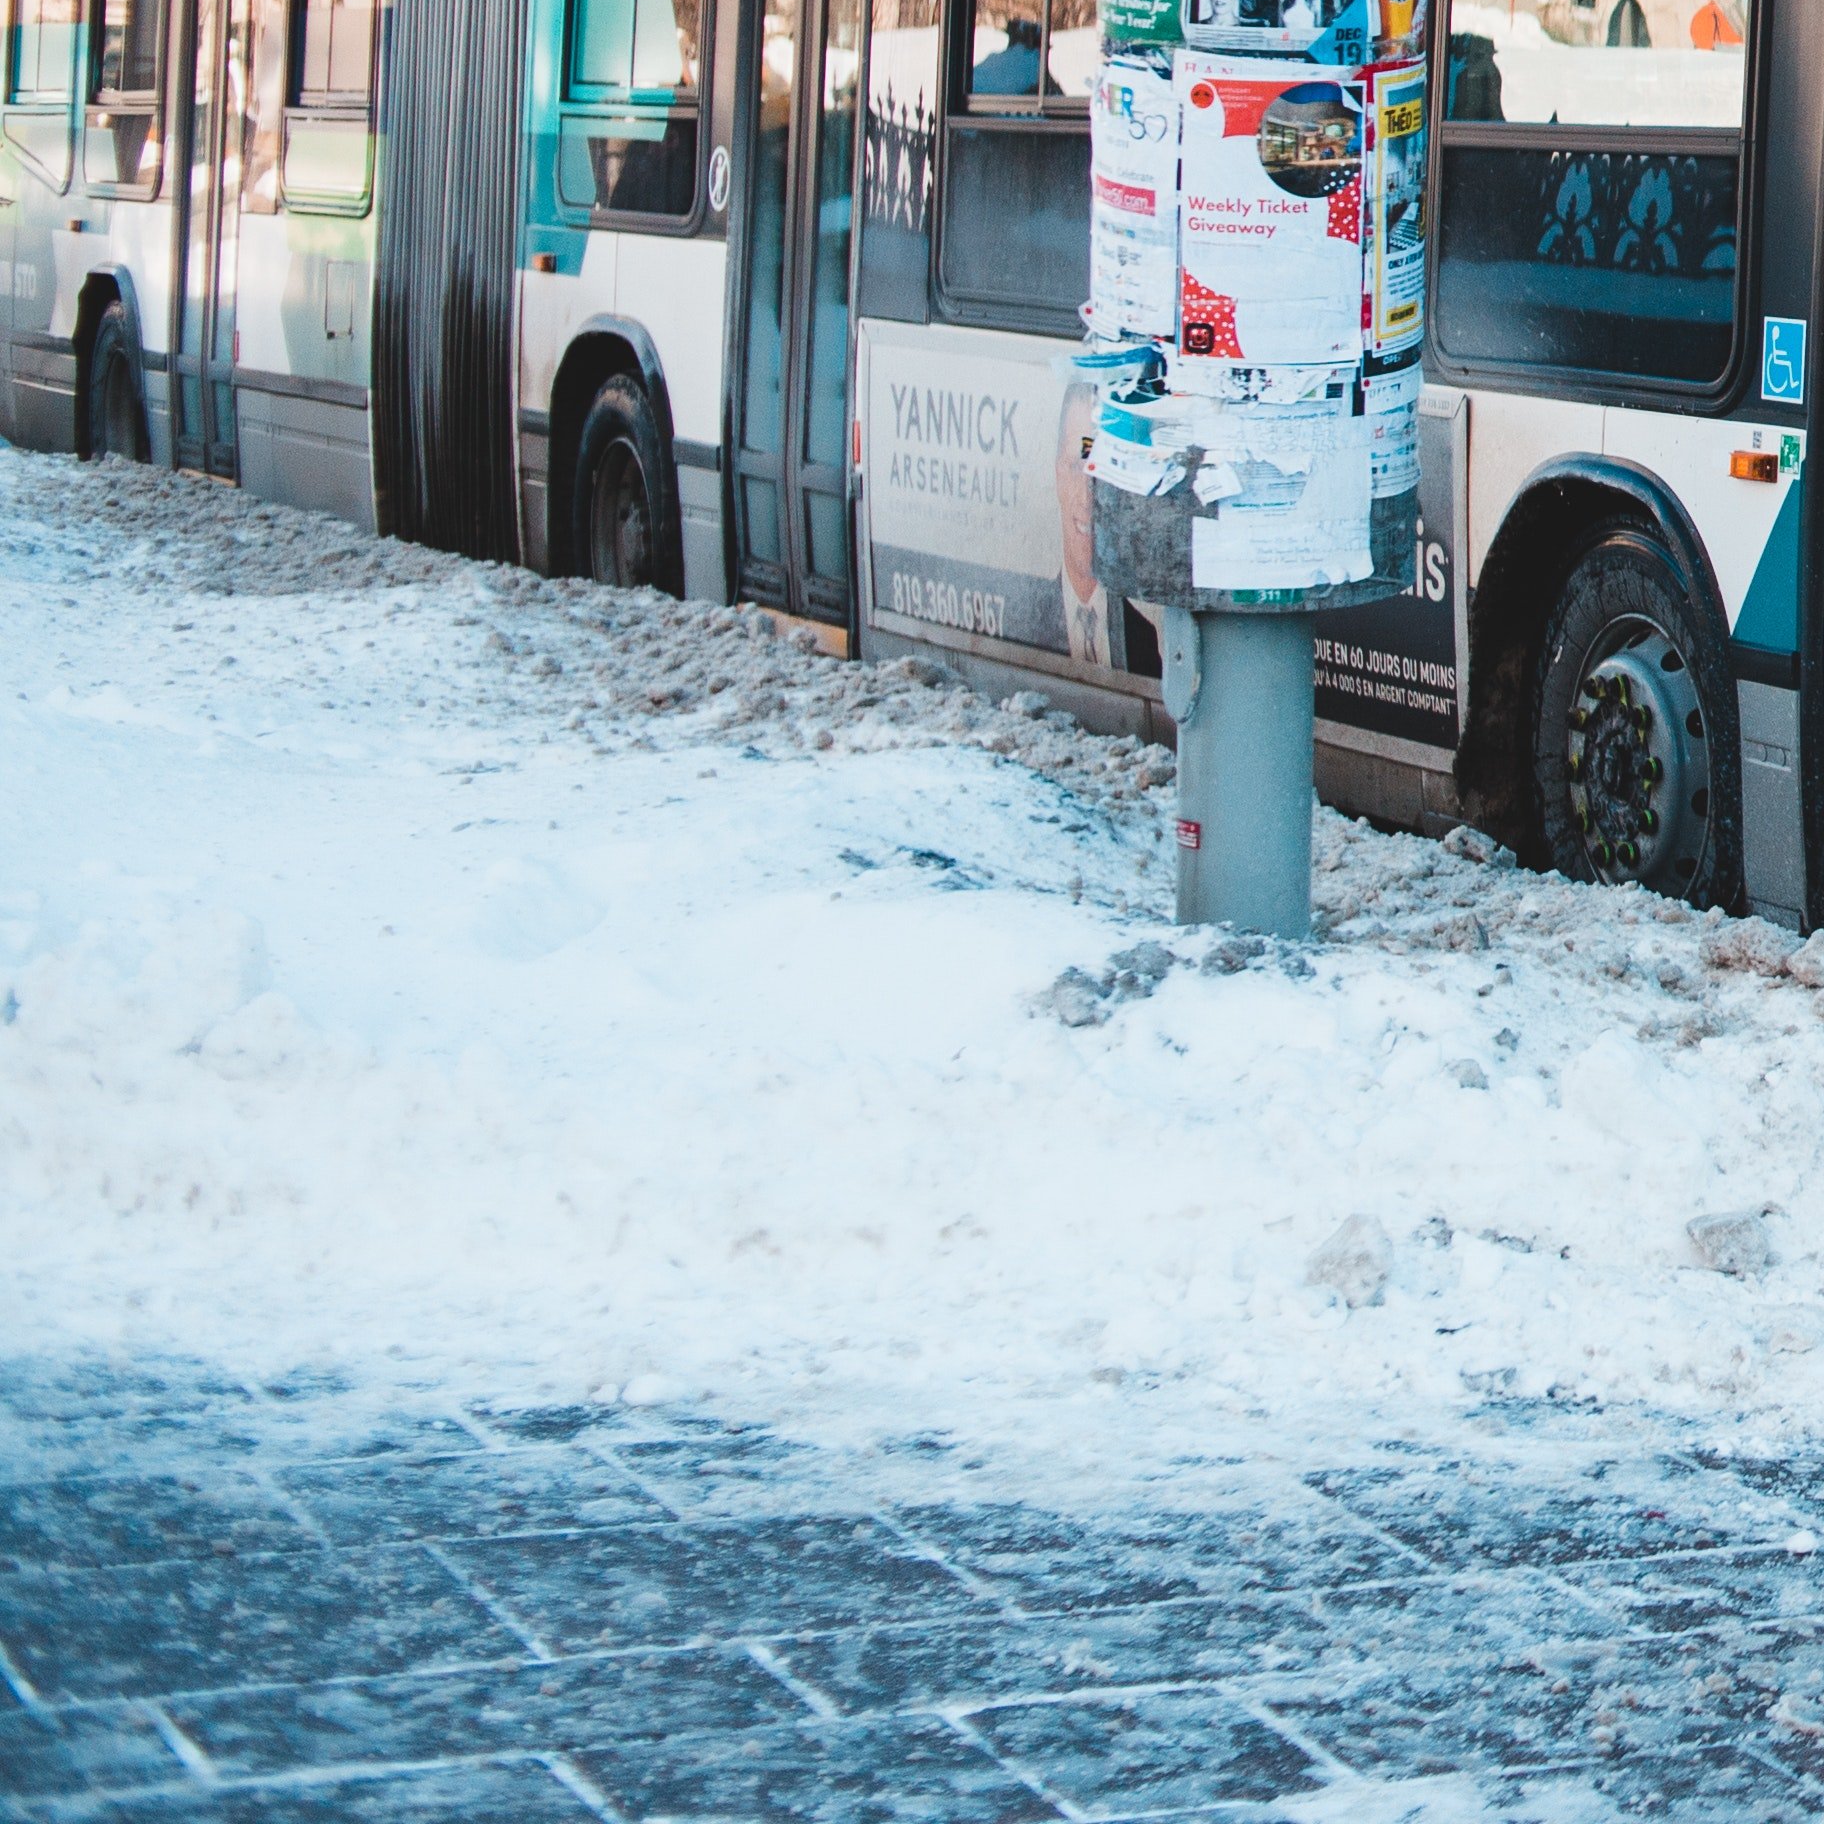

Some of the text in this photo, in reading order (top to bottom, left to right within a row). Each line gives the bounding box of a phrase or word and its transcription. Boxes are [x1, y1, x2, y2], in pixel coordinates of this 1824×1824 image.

[1334, 42, 1362, 66] 19
[1335, 28, 1362, 42] DEC
[1188, 196, 1310, 216] Weekly Ticket
[1187, 217, 1278, 239] Giveaway
[890, 383, 1019, 458] YANNICK
[889, 451, 1020, 508] ARSENEAULT
[1401, 518, 1446, 603] is
[893, 571, 1006, 637] 819.360.6967
[1334, 641, 1348, 666] EN
[1350, 645, 1364, 670] 60
[1366, 649, 1401, 679] JOURS
[1402, 657, 1418, 683] OU
[1420, 660, 1456, 690] MOINS
[1356, 676, 1362, 697] $
[1362, 679, 1374, 699] EN
[1375, 682, 1406, 706] ARGENT
